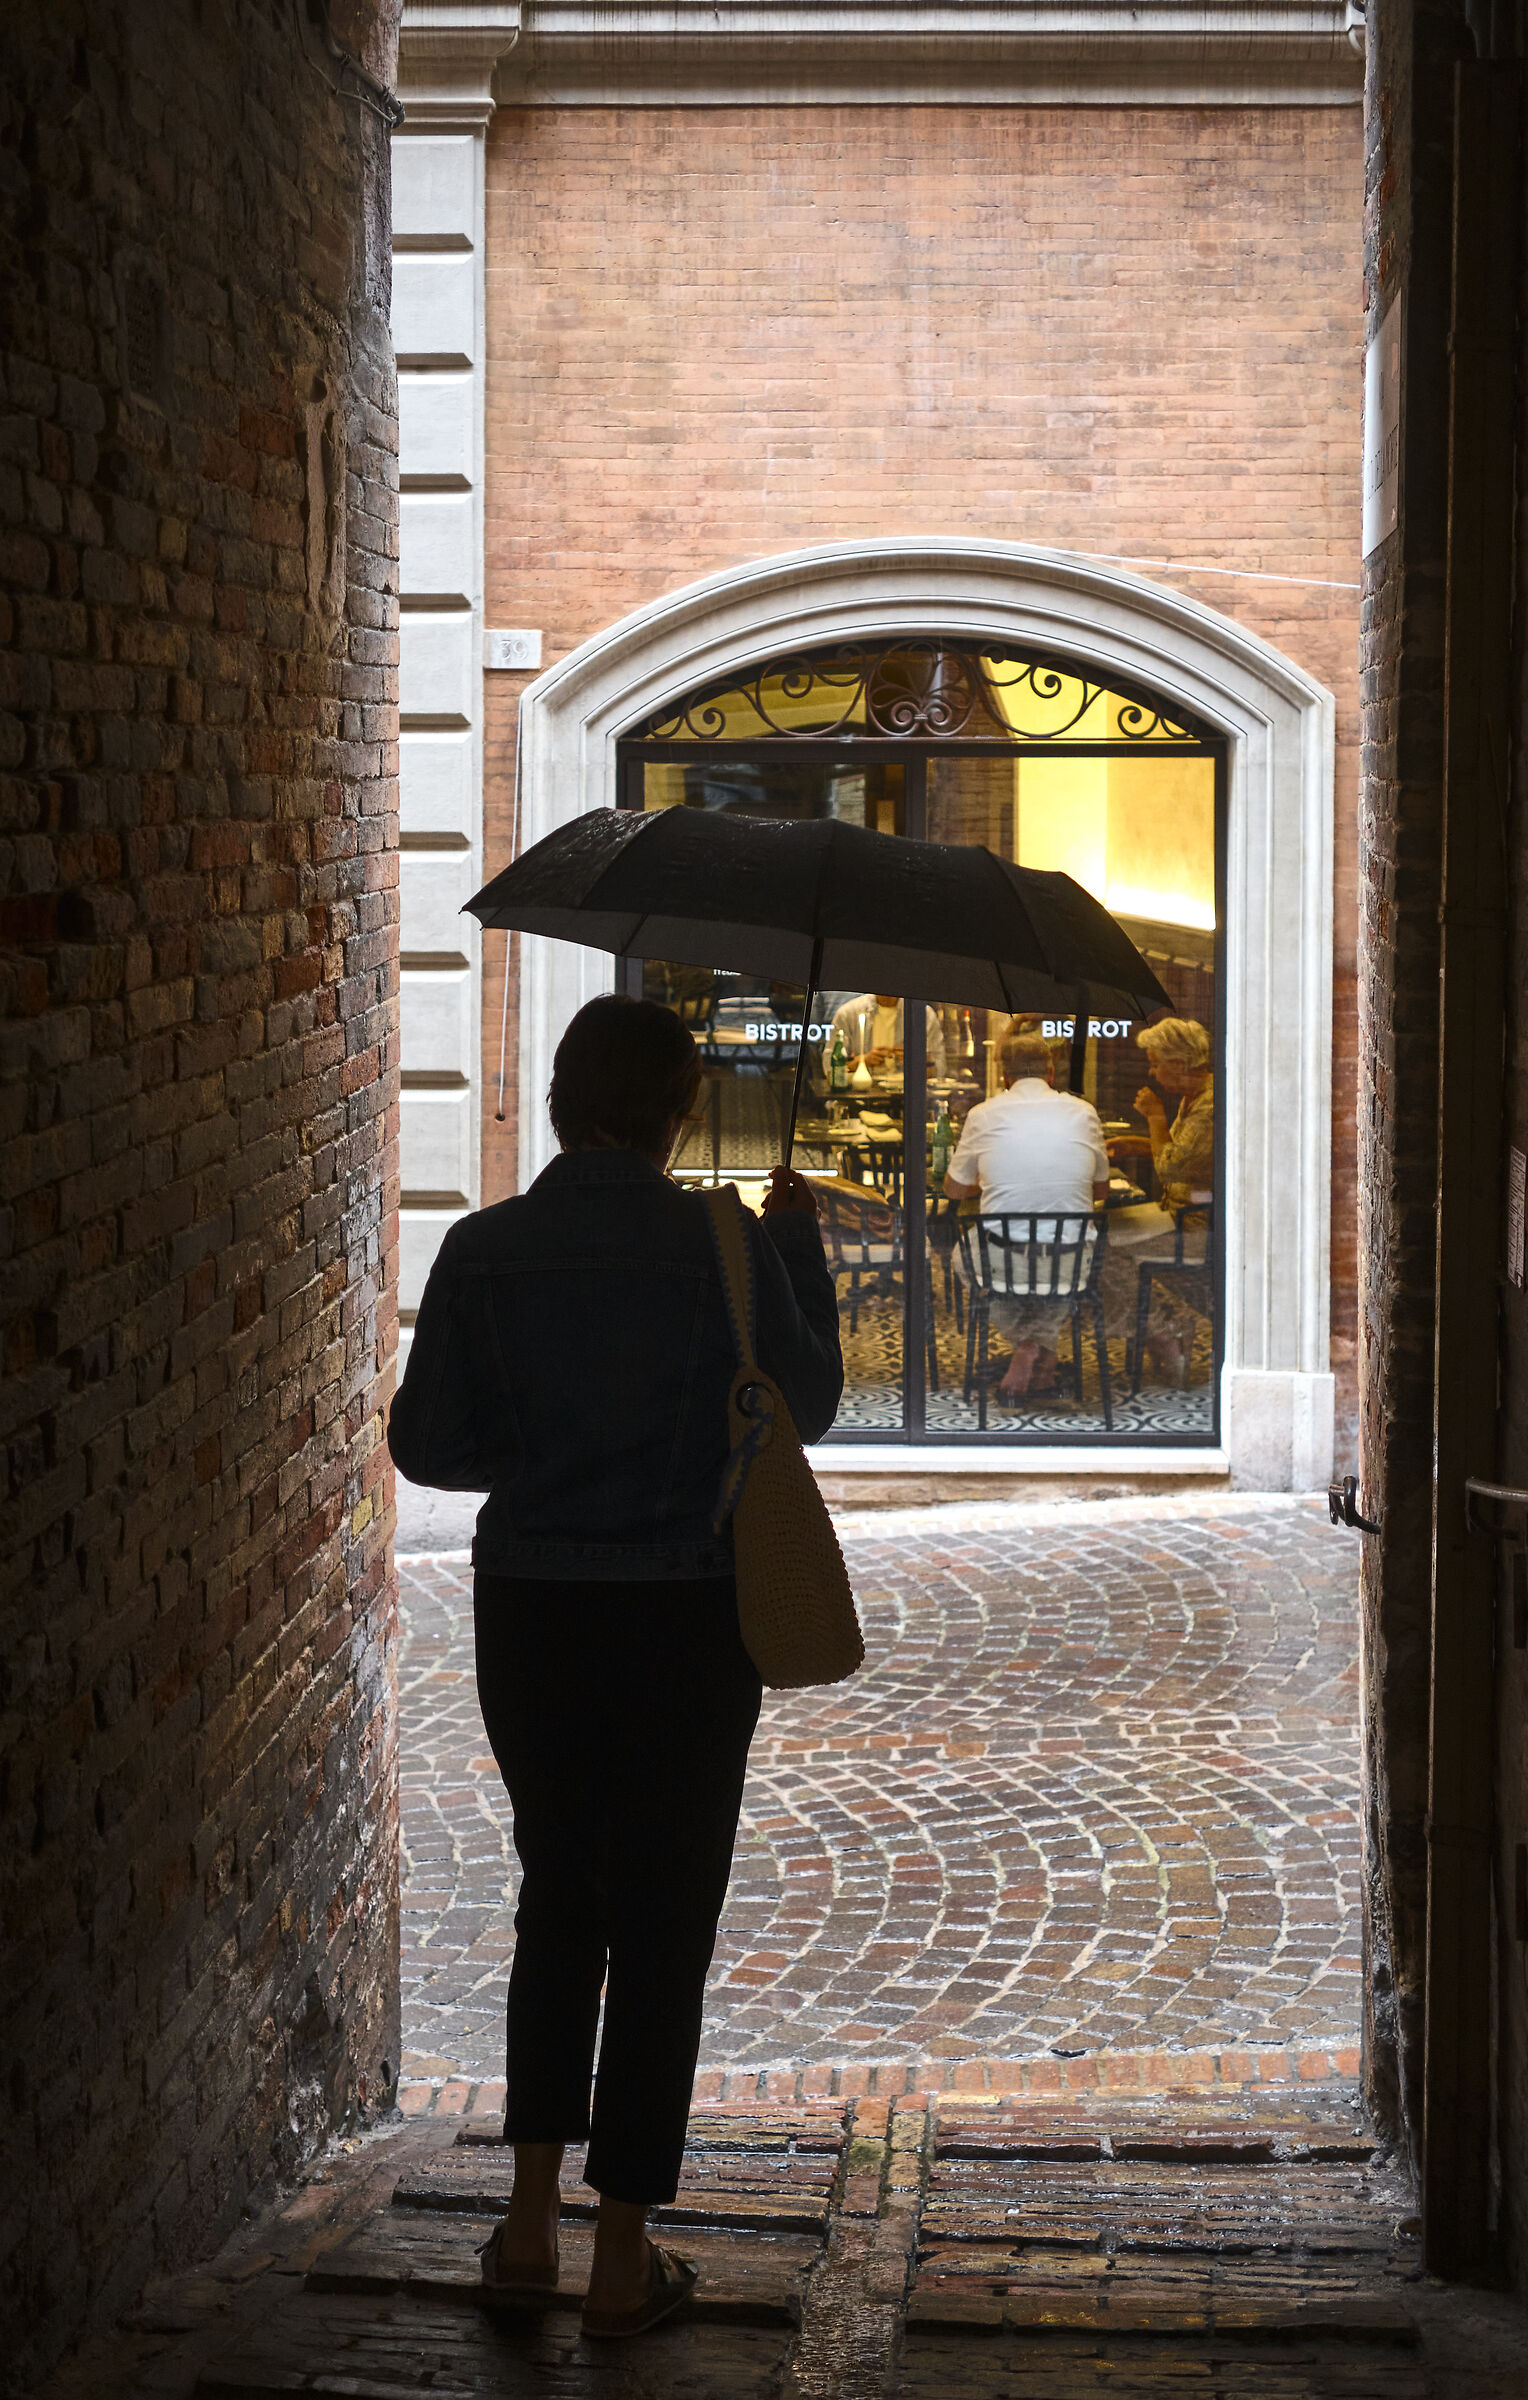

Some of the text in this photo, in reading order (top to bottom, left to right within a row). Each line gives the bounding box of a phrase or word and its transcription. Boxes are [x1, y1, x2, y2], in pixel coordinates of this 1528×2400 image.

[498, 639, 529, 660] 39
[745, 1023, 835, 1041] BISTROT
[1041, 1020, 1133, 1038] BISROT
